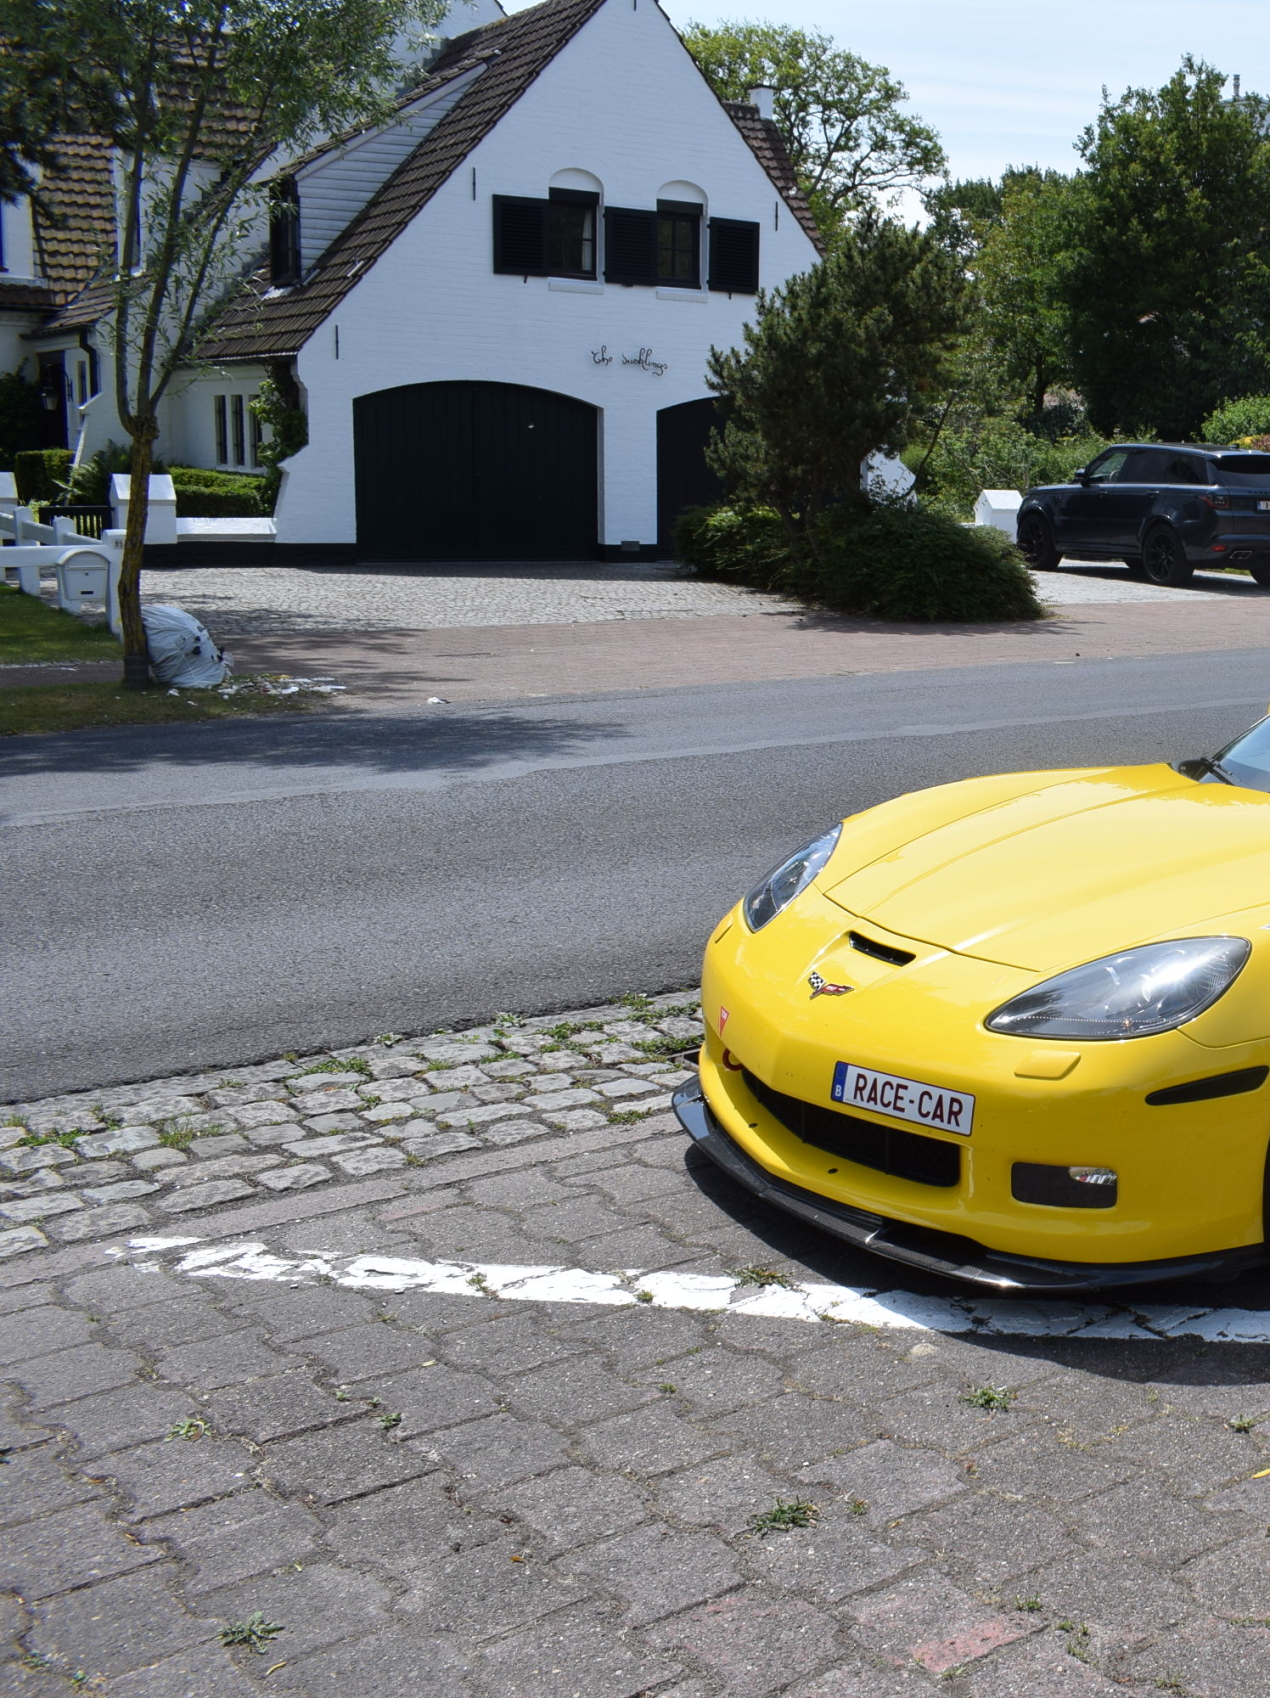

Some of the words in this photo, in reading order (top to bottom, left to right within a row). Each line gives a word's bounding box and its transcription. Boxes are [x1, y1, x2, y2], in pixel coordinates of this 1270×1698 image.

[591, 345, 613, 366] The
[834, 1084, 842, 1097] B
[853, 1072, 963, 1127] RACE-CAR
